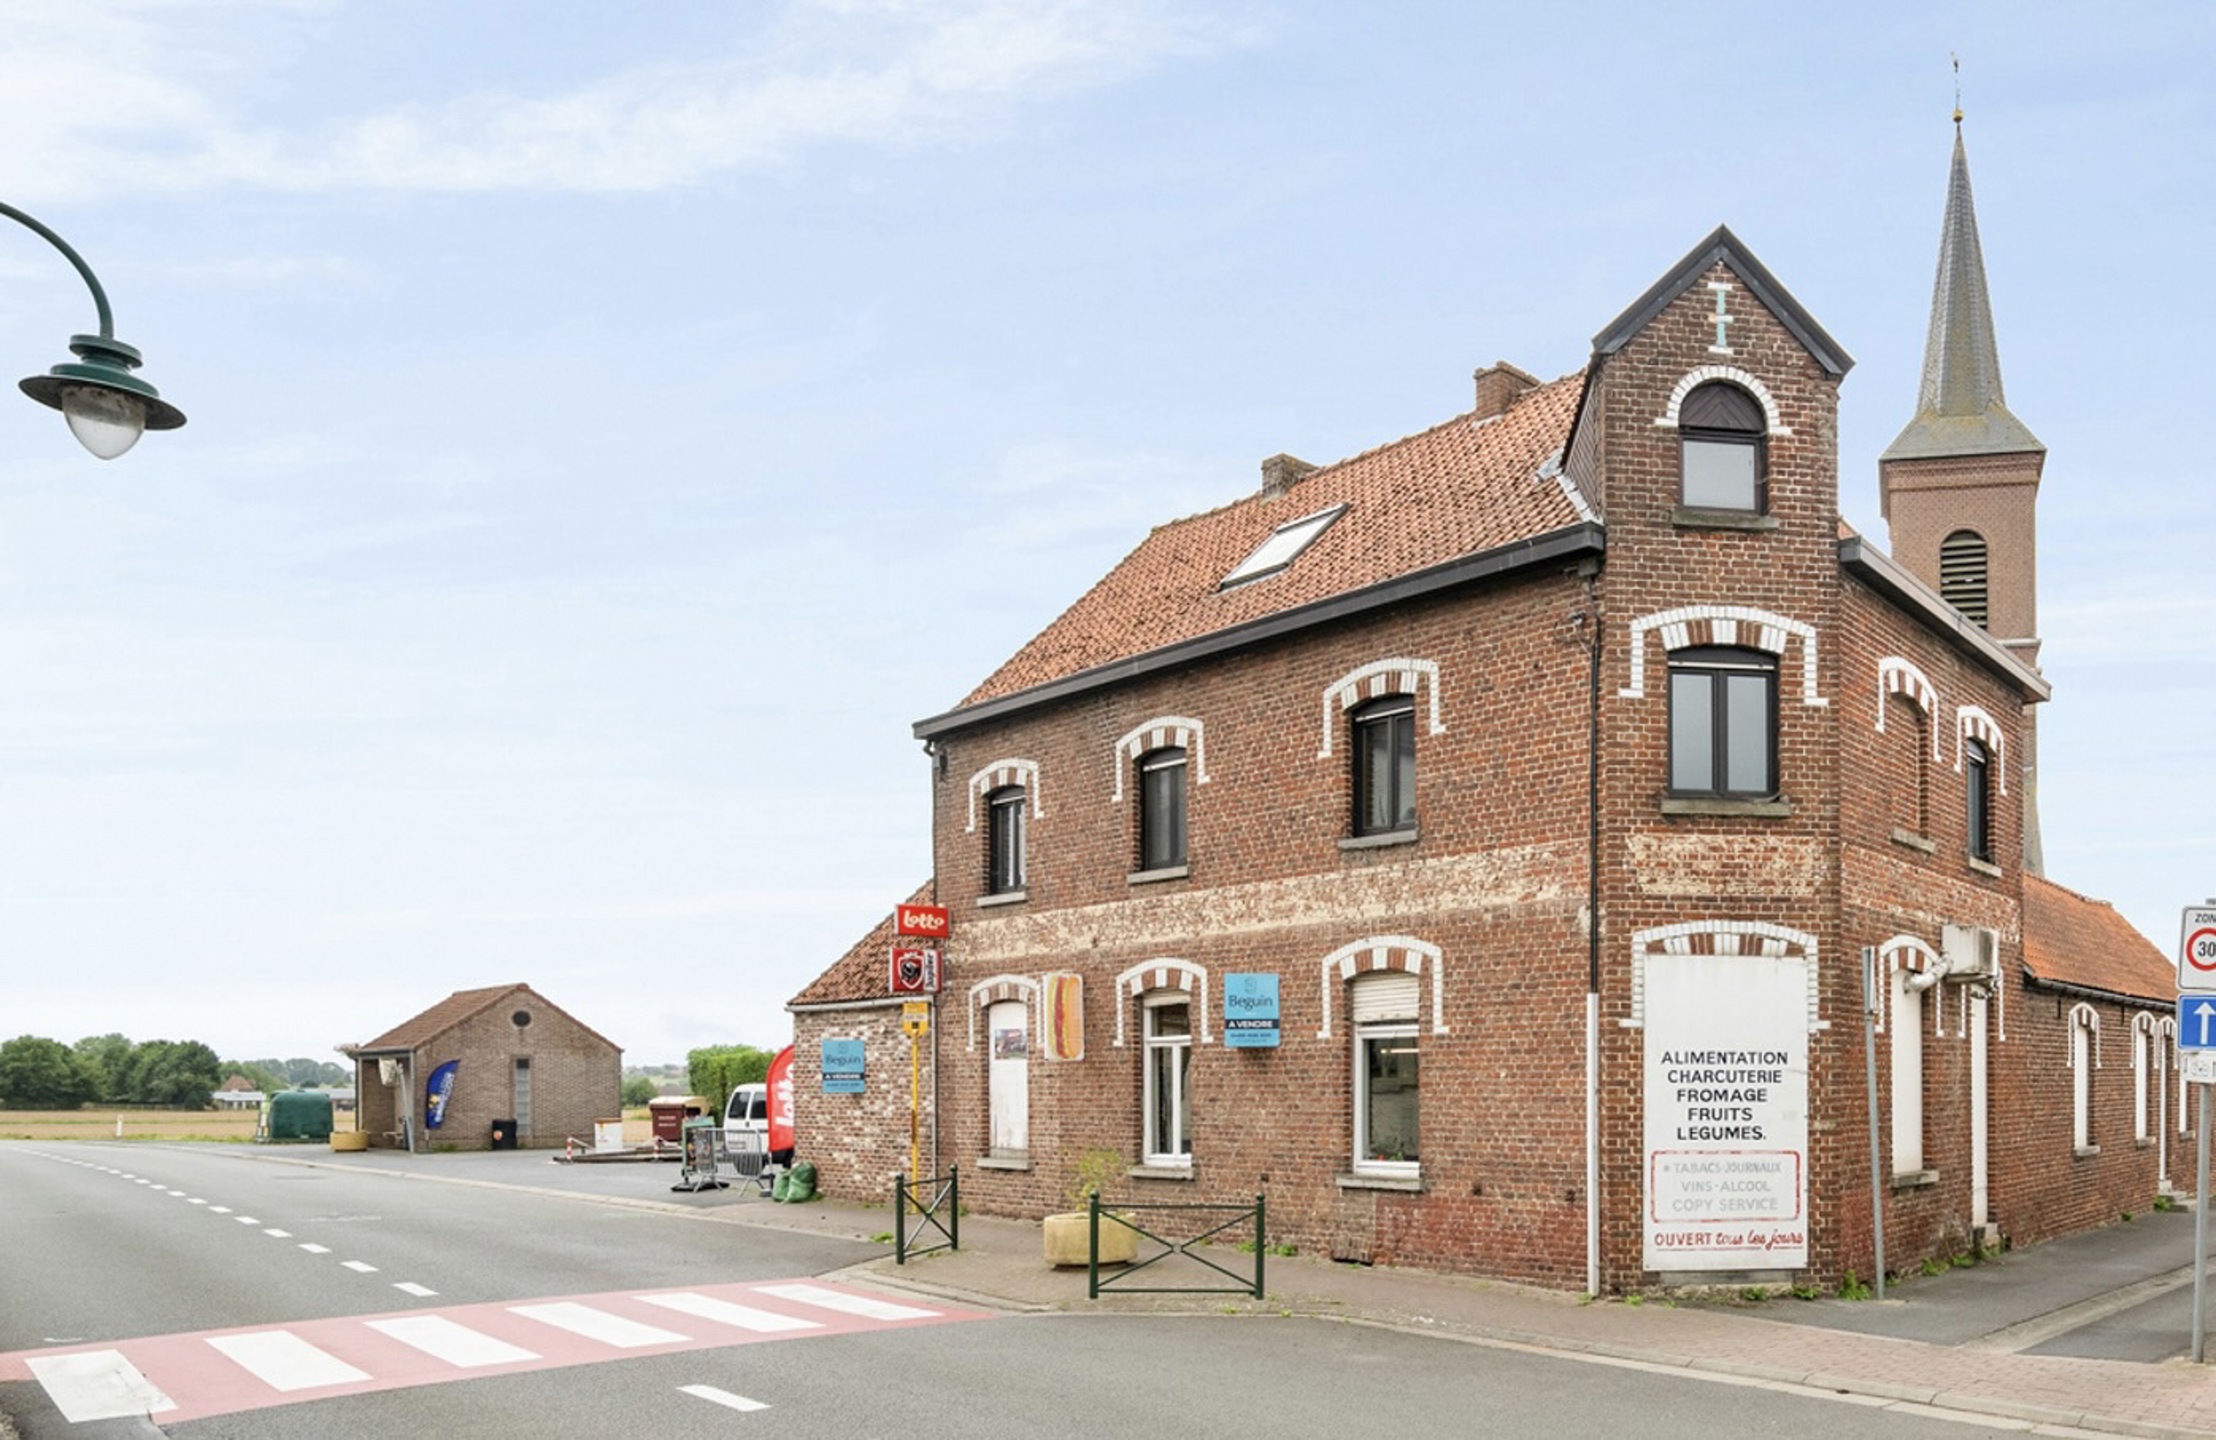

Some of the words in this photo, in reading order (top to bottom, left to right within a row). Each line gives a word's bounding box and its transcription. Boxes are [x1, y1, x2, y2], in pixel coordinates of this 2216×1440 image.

[2197, 941, 2216, 958] 30
[1228, 994, 1274, 1011] Beguin
[1228, 1020, 1236, 1028] A
[1236, 1020, 1273, 1028] VENDRE
[1661, 1051, 1789, 1065] ALIMENTATION
[1667, 1069, 1782, 1084] CHARCUTERIE
[1676, 1088, 1768, 1103] FROMAGE
[1687, 1107, 1753, 1121] FRUITS
[1677, 1126, 1767, 1140] LEGUMES.
[1719, 1180, 1771, 1192] ALCOOL
[1672, 1199, 1713, 1212] COPY
[1718, 1197, 1778, 1211] SERVICE
[1654, 1232, 1712, 1246] OUVERT
[1715, 1232, 1743, 1245] tous
[1747, 1229, 1766, 1244] les
[1764, 1228, 1804, 1251] jours
